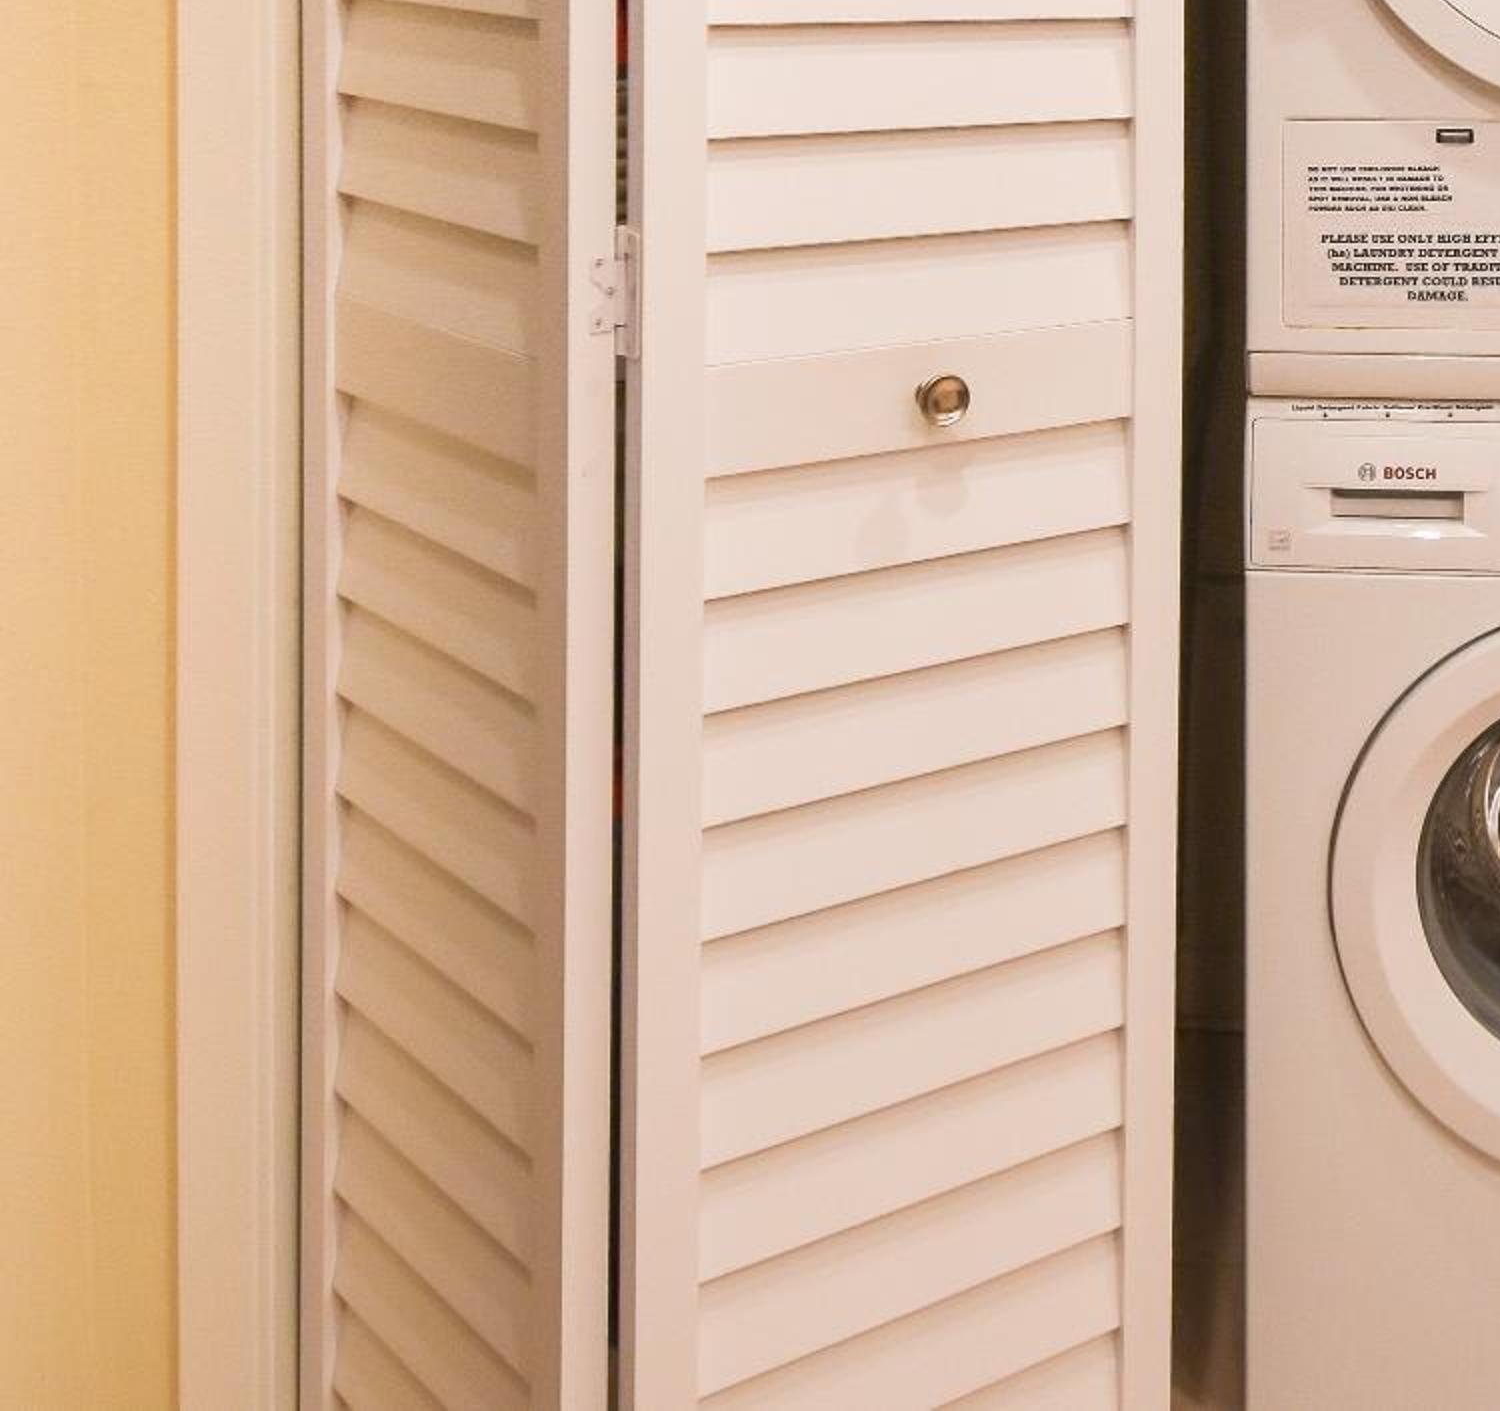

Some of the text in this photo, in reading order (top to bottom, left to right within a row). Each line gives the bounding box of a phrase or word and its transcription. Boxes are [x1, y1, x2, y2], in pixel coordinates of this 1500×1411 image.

[1320, 234, 1368, 243] PLEASE
[1371, 234, 1394, 243] USE
[1397, 234, 1433, 243] ONLY
[1437, 234, 1471, 243] HIGH
[1353, 249, 1415, 257] LAUNDRY
[1418, 249, 1498, 257] DETERGENT
[1332, 263, 1398, 271] MACHINE.
[1405, 263, 1428, 271] USE
[1432, 263, 1450, 271] OF
[1339, 277, 1418, 285] DETERGENT
[1422, 277, 1468, 285] COULD
[1407, 291, 1468, 301] DAMAGE.
[1383, 467, 1437, 480] BOSCH
